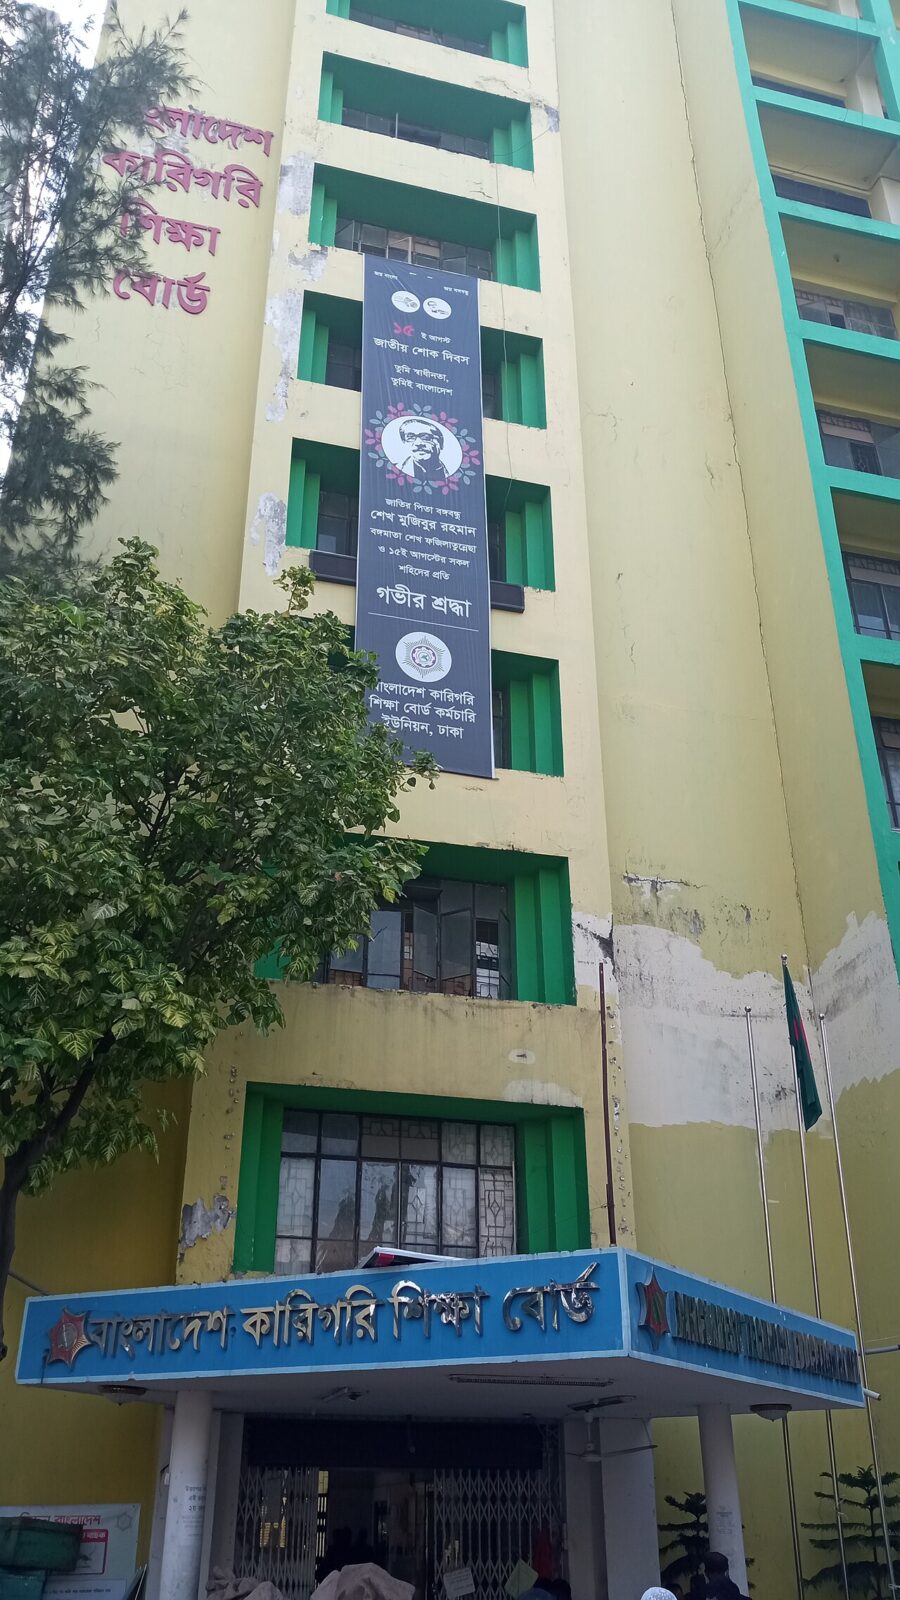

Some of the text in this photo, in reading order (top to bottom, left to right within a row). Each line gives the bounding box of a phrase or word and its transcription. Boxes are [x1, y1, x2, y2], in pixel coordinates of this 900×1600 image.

[144, 105, 273, 157] ংলাদেশ
[103, 146, 263, 208] কারিগরি
[113, 271, 210, 315] বোর্ড
[373, 337, 471, 365] জাতীয় শোক দিবস
[394, 364, 411, 375] তুমি
[415, 382, 453, 396] বাংলাদেশ
[385, 498, 411, 510] জাতির
[414, 502, 433, 514] পিতা
[370, 510, 477, 537] শেখ মুজিবুর রহমান
[405, 534, 422, 544] শেখ
[378, 545, 386, 553] ও
[389, 547, 408, 558] ১৫ই
[448, 557, 470, 568] সকল
[398, 564, 451, 580] শহিদের প্রতি
[376, 583, 472, 618] গভীর শ্রদ্ধা
[368, 694, 477, 723] শিক্ষা বোর্ড কর্মচারি
[428, 688, 475, 706] কারিগরি
[437, 724, 464, 739] ঢাকা
[87, 1262, 600, 1360] বাংলাদেশ কারিগরি শিক্ষা বোর্ড
